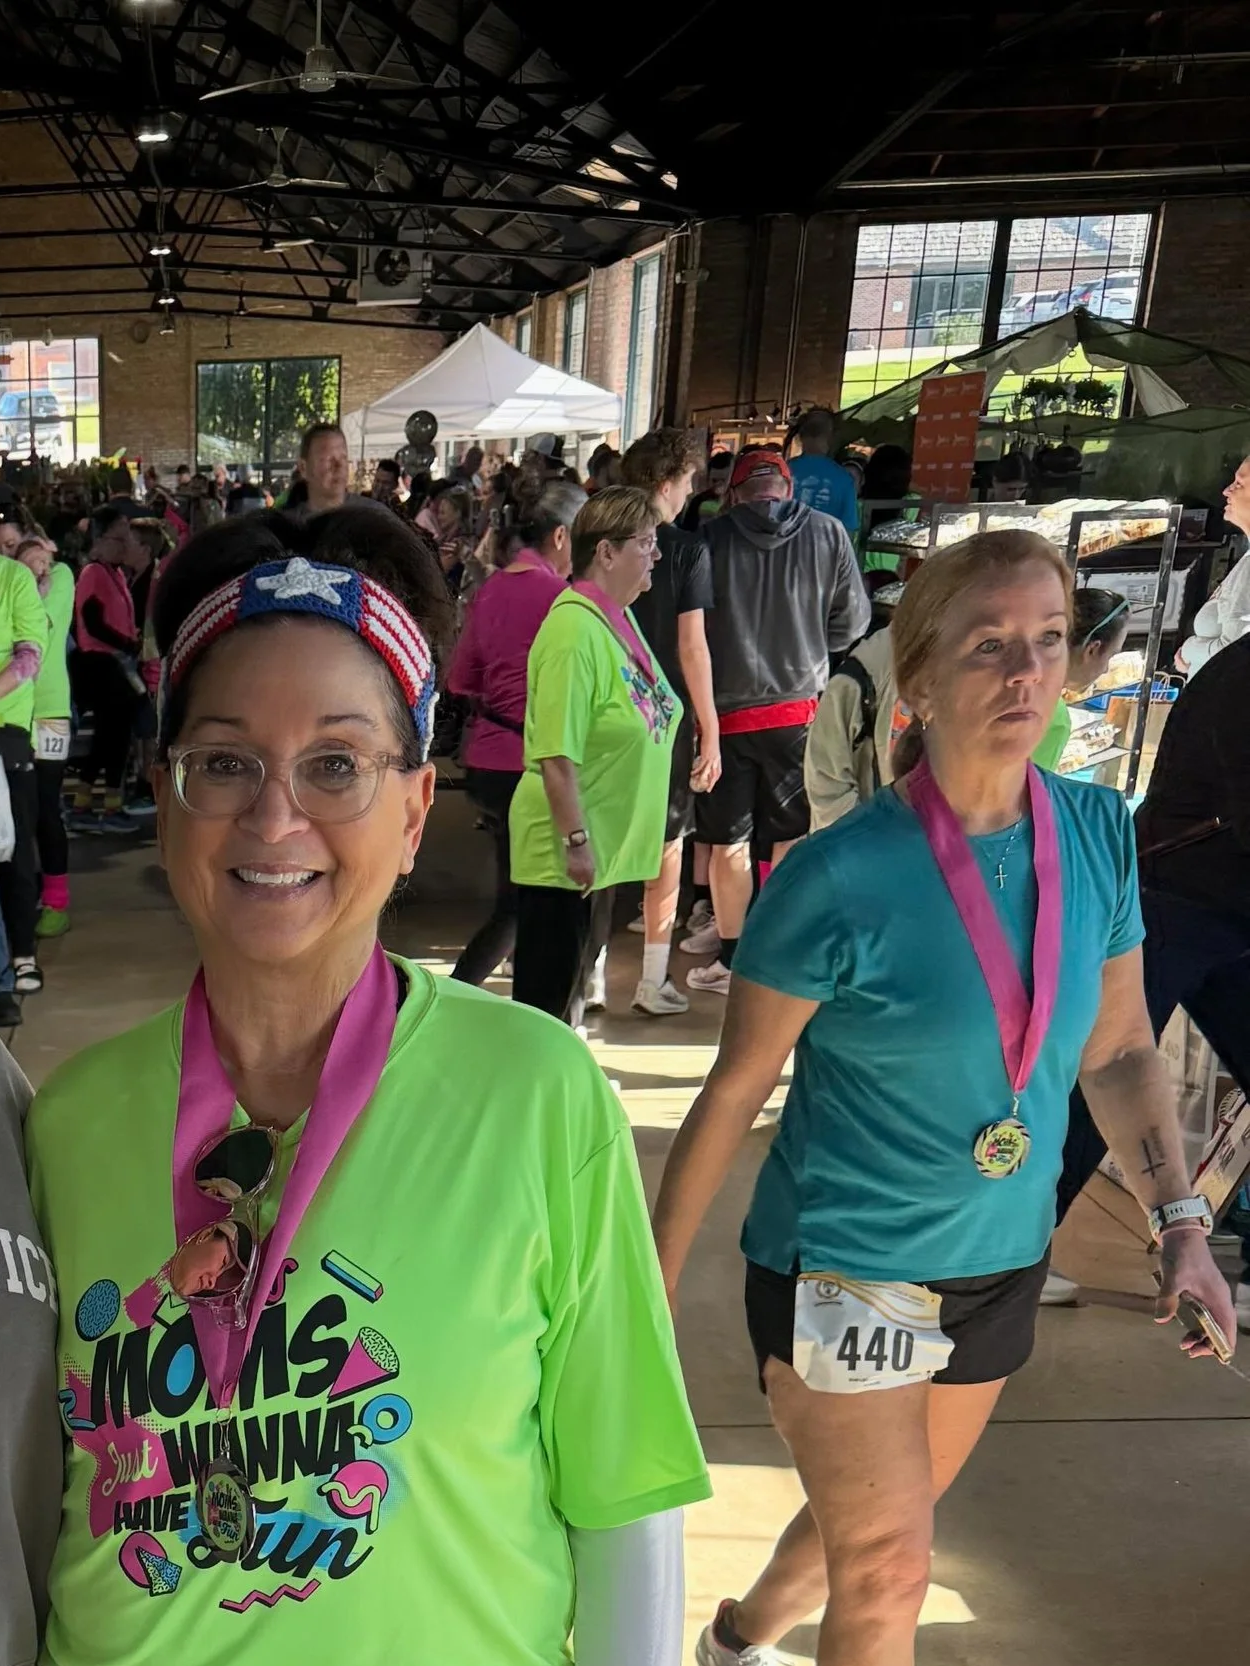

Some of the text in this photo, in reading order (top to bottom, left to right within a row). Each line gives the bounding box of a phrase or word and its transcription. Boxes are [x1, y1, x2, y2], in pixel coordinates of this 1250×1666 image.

[90, 1294, 350, 1431] MOMS
[836, 1326, 915, 1372] 440
[102, 1440, 159, 1497] Just
[113, 1492, 192, 1535] HAVE
